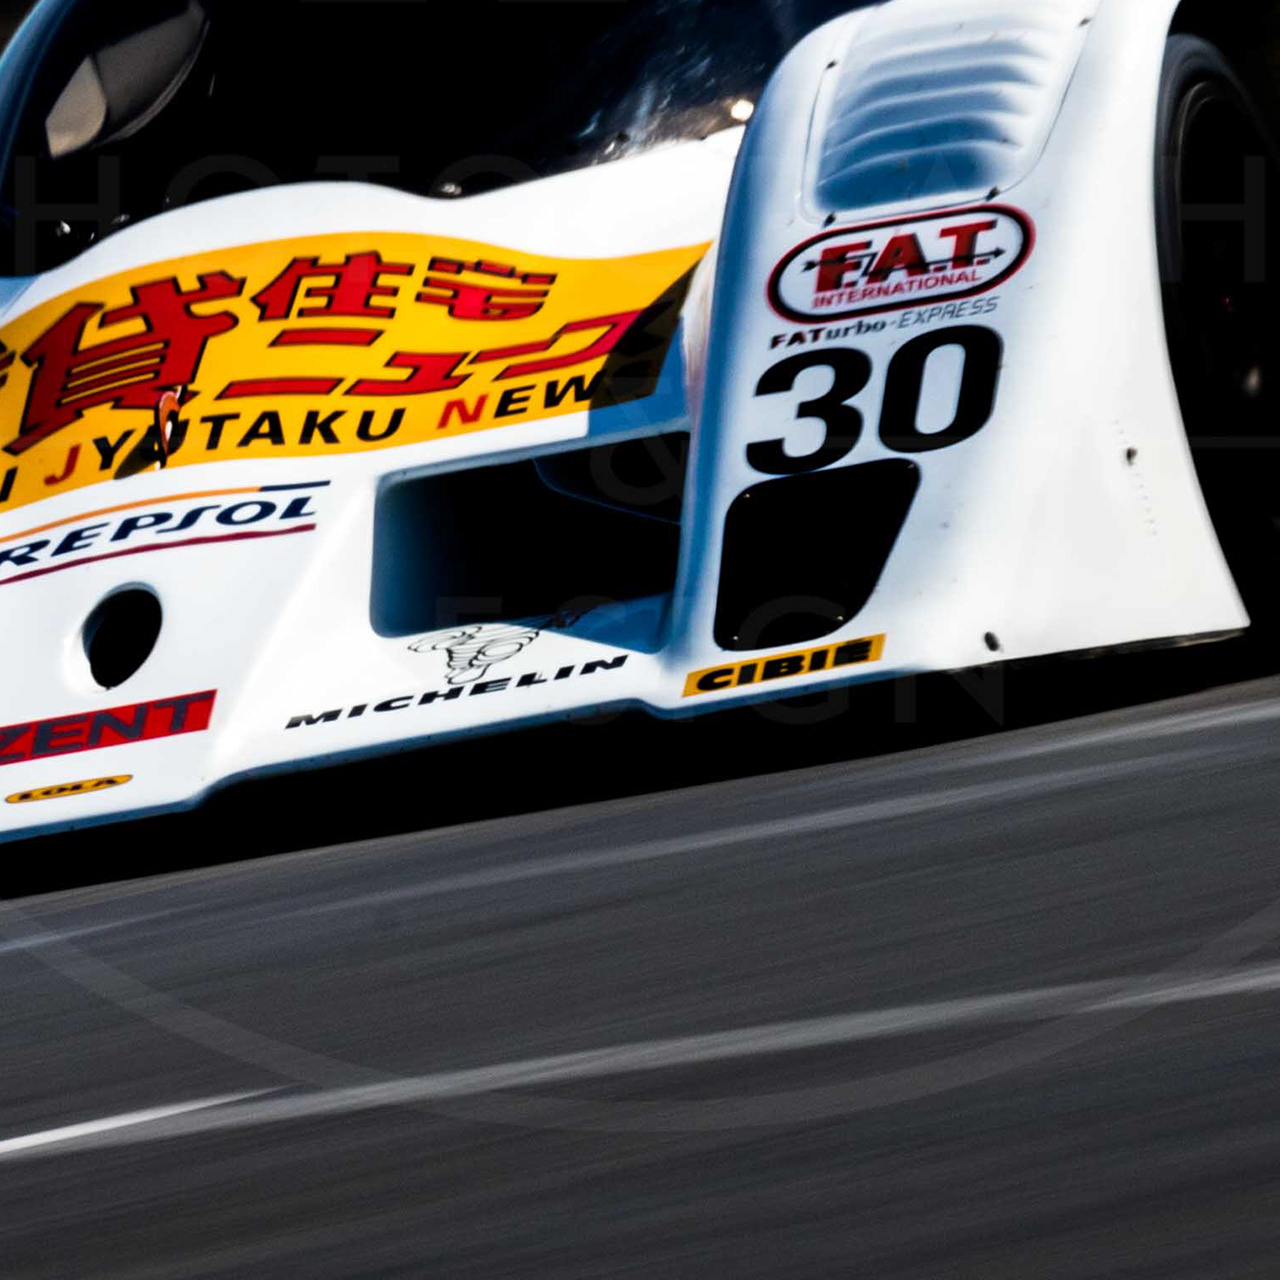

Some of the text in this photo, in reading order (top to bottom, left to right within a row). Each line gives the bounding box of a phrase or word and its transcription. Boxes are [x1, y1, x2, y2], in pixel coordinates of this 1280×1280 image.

[813, 269, 982, 309] INTERNATIONAL
[746, 324, 1004, 475] 30
[285, 655, 629, 729] MICHELIN
